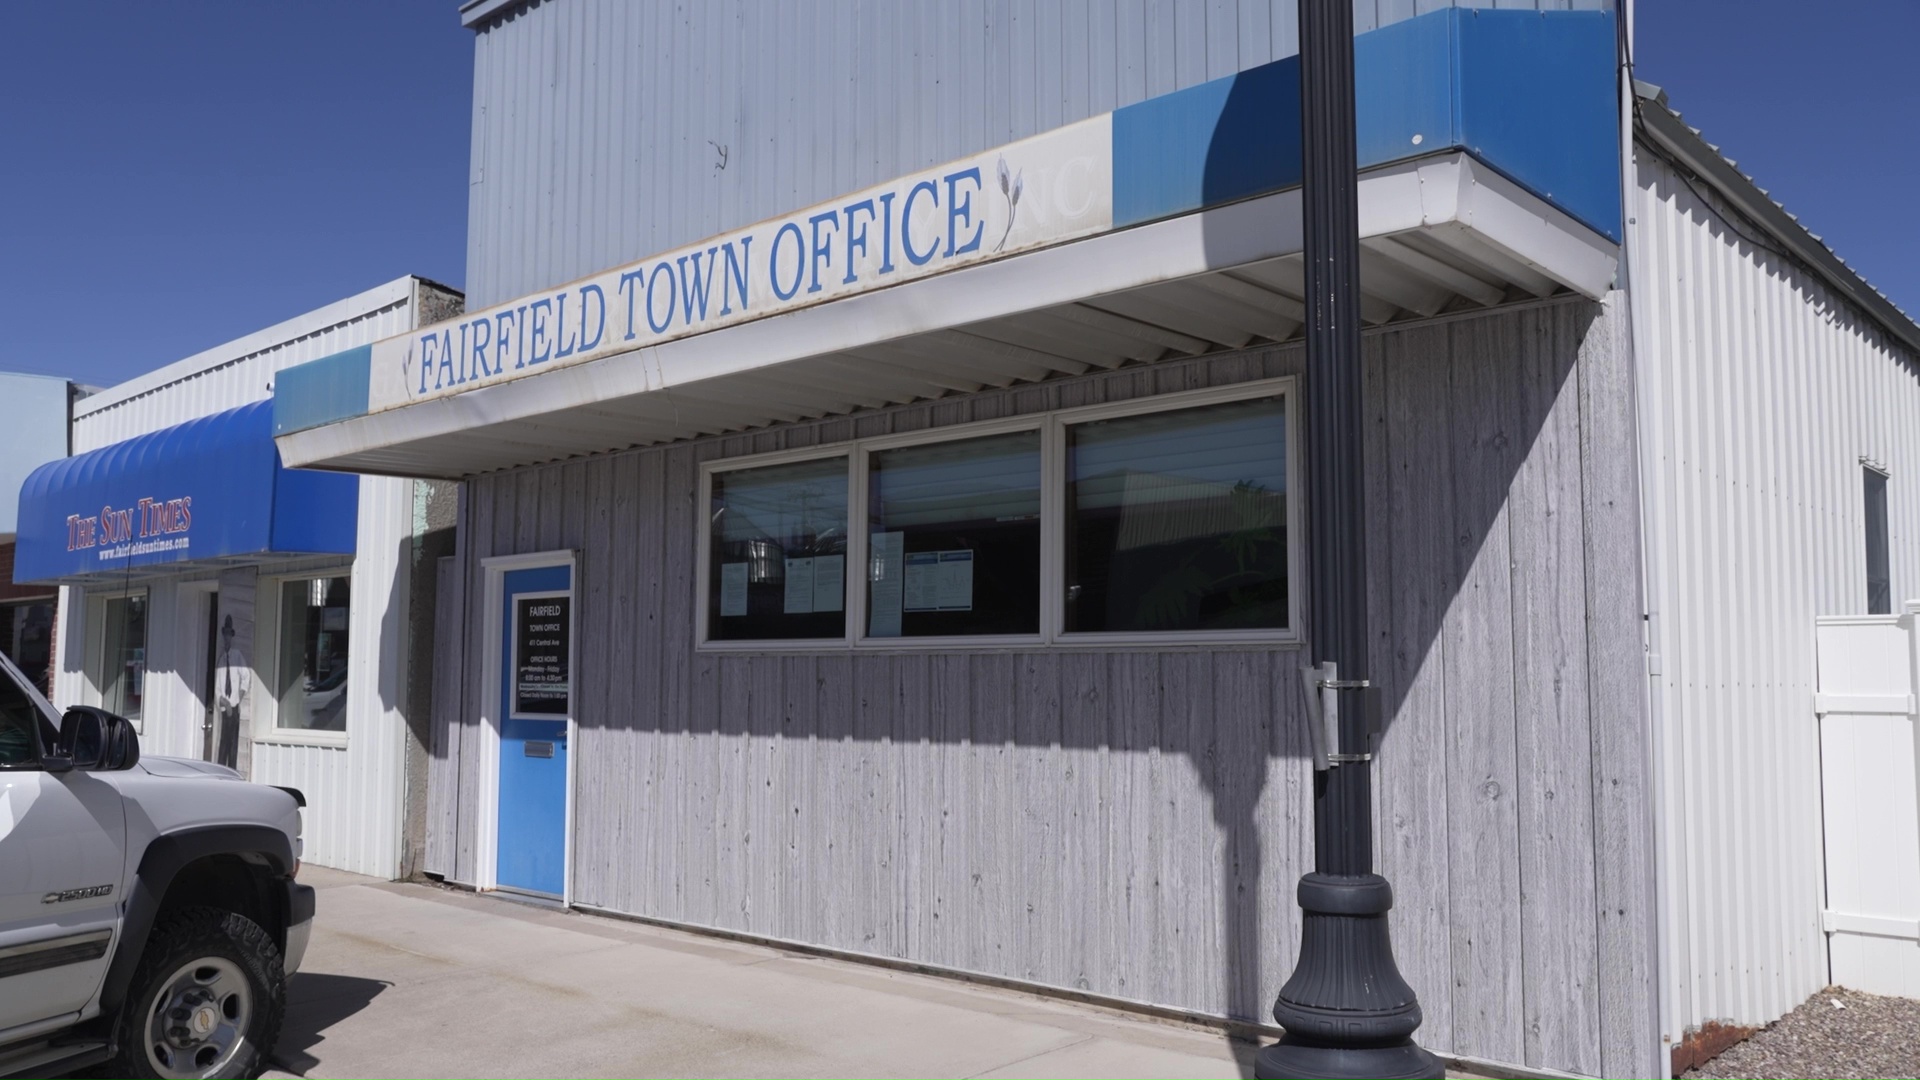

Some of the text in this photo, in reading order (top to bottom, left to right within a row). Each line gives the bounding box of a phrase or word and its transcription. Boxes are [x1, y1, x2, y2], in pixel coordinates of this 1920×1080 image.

[418, 166, 985, 394] FAIRFIELD TOWN OFFICE
[529, 606, 560, 616] FAIRFIELD
[529, 623, 560, 632] TOWN OFFICE
[530, 655, 558, 663] OFFICE HOURS
